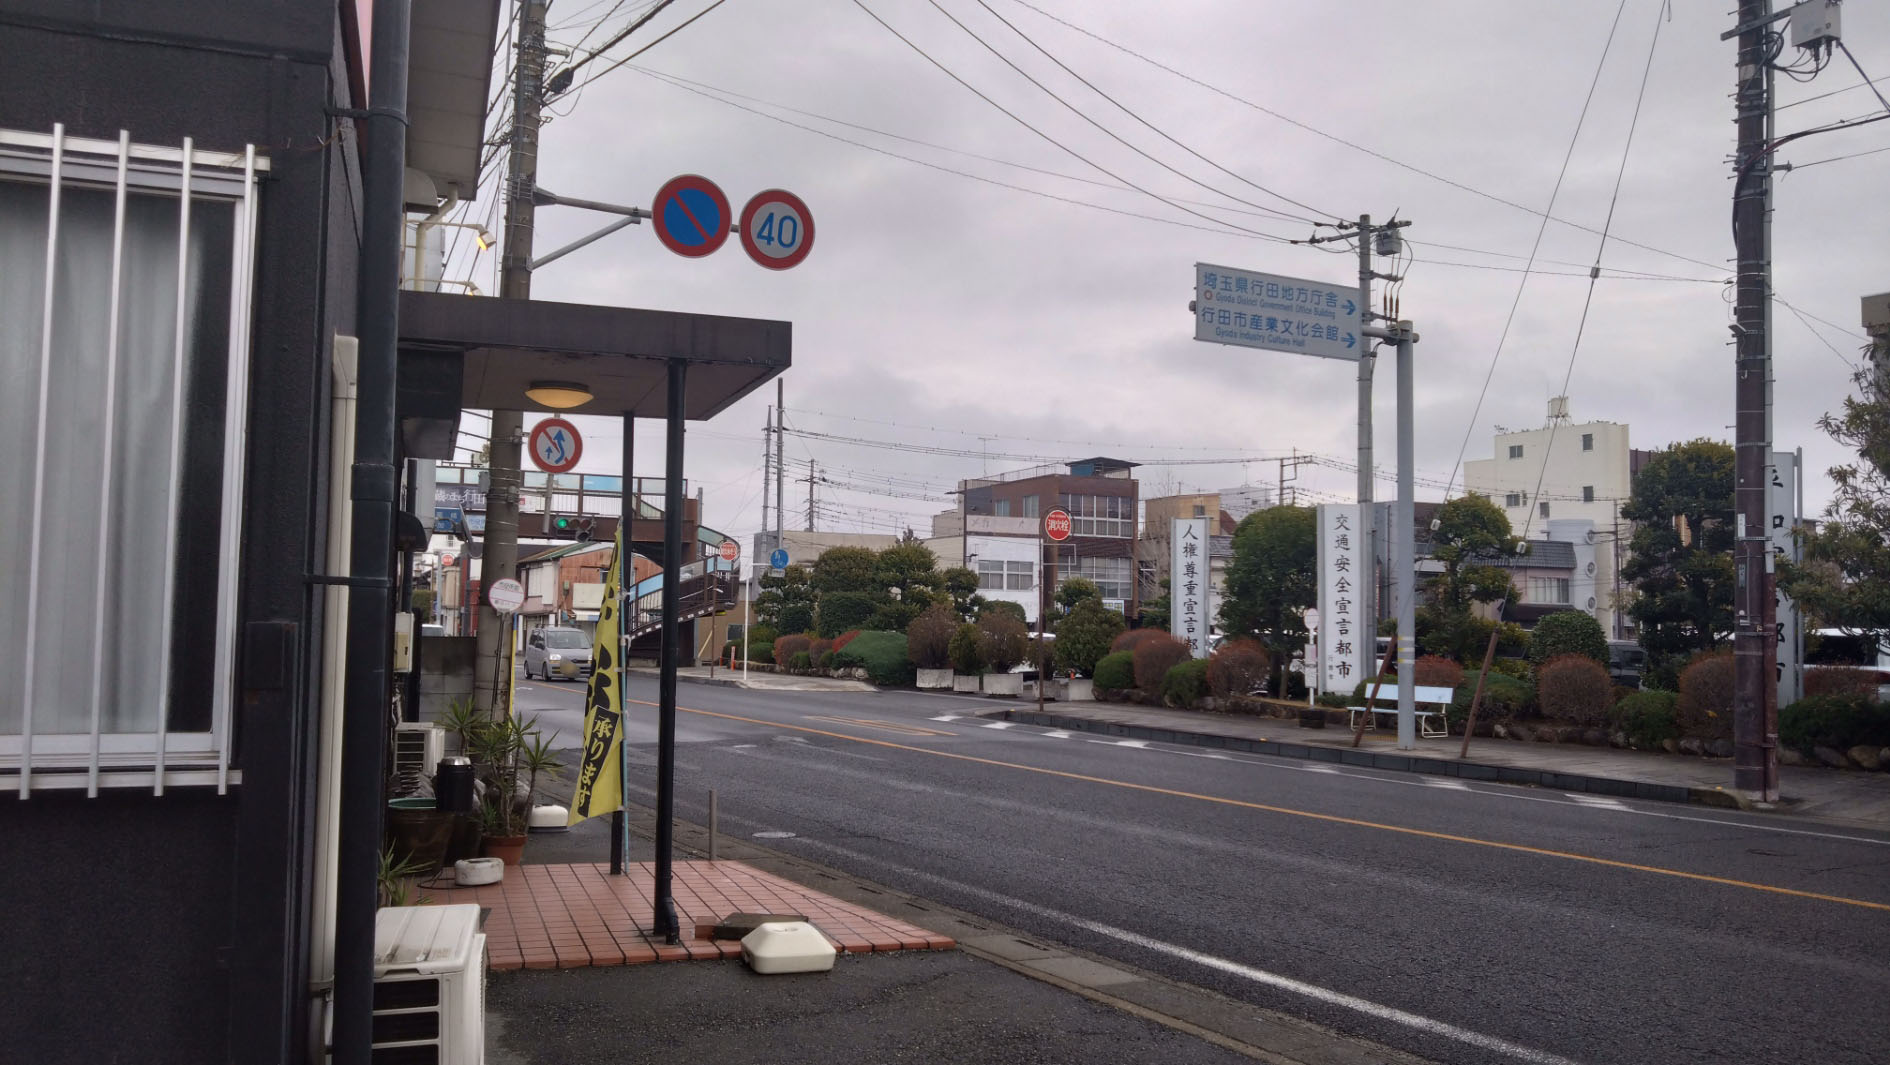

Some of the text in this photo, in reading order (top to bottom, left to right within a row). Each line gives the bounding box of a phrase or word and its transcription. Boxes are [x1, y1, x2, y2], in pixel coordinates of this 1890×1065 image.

[757, 212, 798, 248] 40
[1203, 271, 1339, 308] 埼玉県行田地方庁舎
[1202, 306, 1339, 342] 行田市産業文化会館
[1048, 519, 1069, 531] 消火栓
[1333, 513, 1352, 679] 交通安全宣言都市
[578, 713, 612, 807] 承ります
